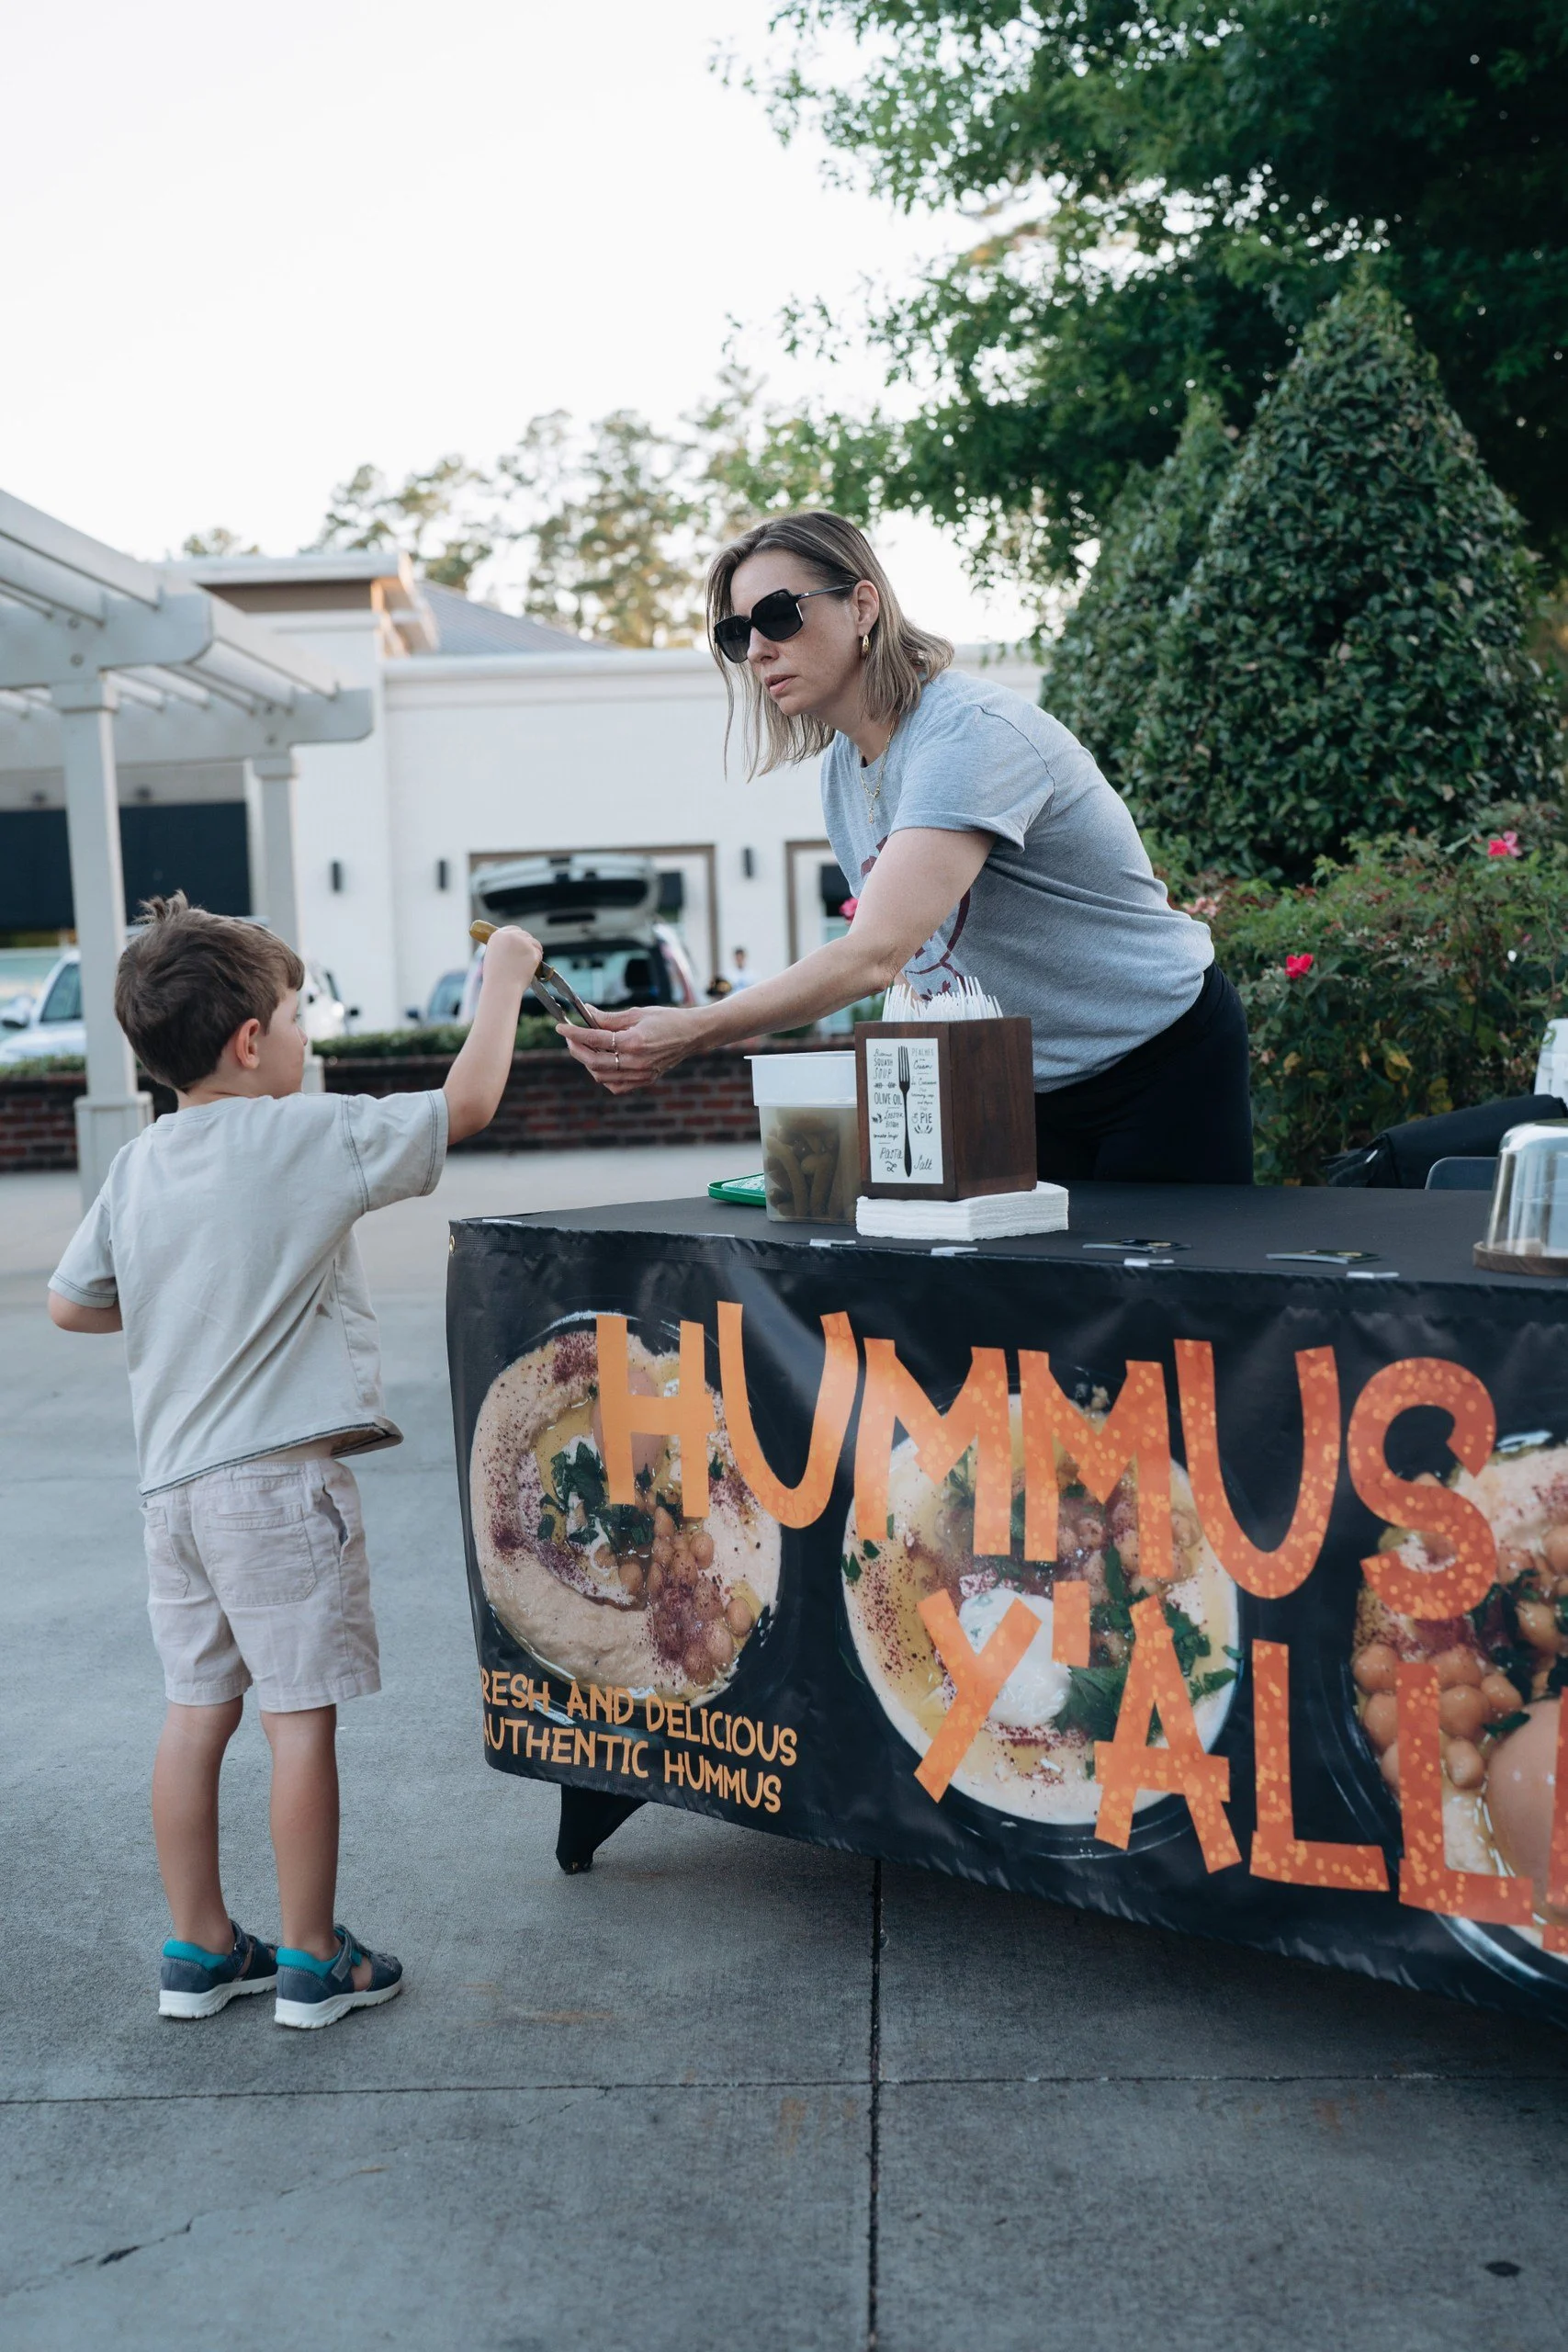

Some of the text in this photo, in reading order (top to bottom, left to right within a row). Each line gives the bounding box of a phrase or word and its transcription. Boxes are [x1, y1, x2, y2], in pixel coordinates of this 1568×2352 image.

[874, 1067, 892, 1080] SOUP
[874, 1092, 891, 1105] OLIVE
[893, 1093, 902, 1105] OIL
[920, 1113, 932, 1124] PIE
[913, 1154, 932, 1170] Salt
[595, 1300, 1497, 1621] HUMMUS
[479, 1667, 797, 1767] RESH AND DELICIOUS
[664, 1749, 781, 1814] HUMMUS
